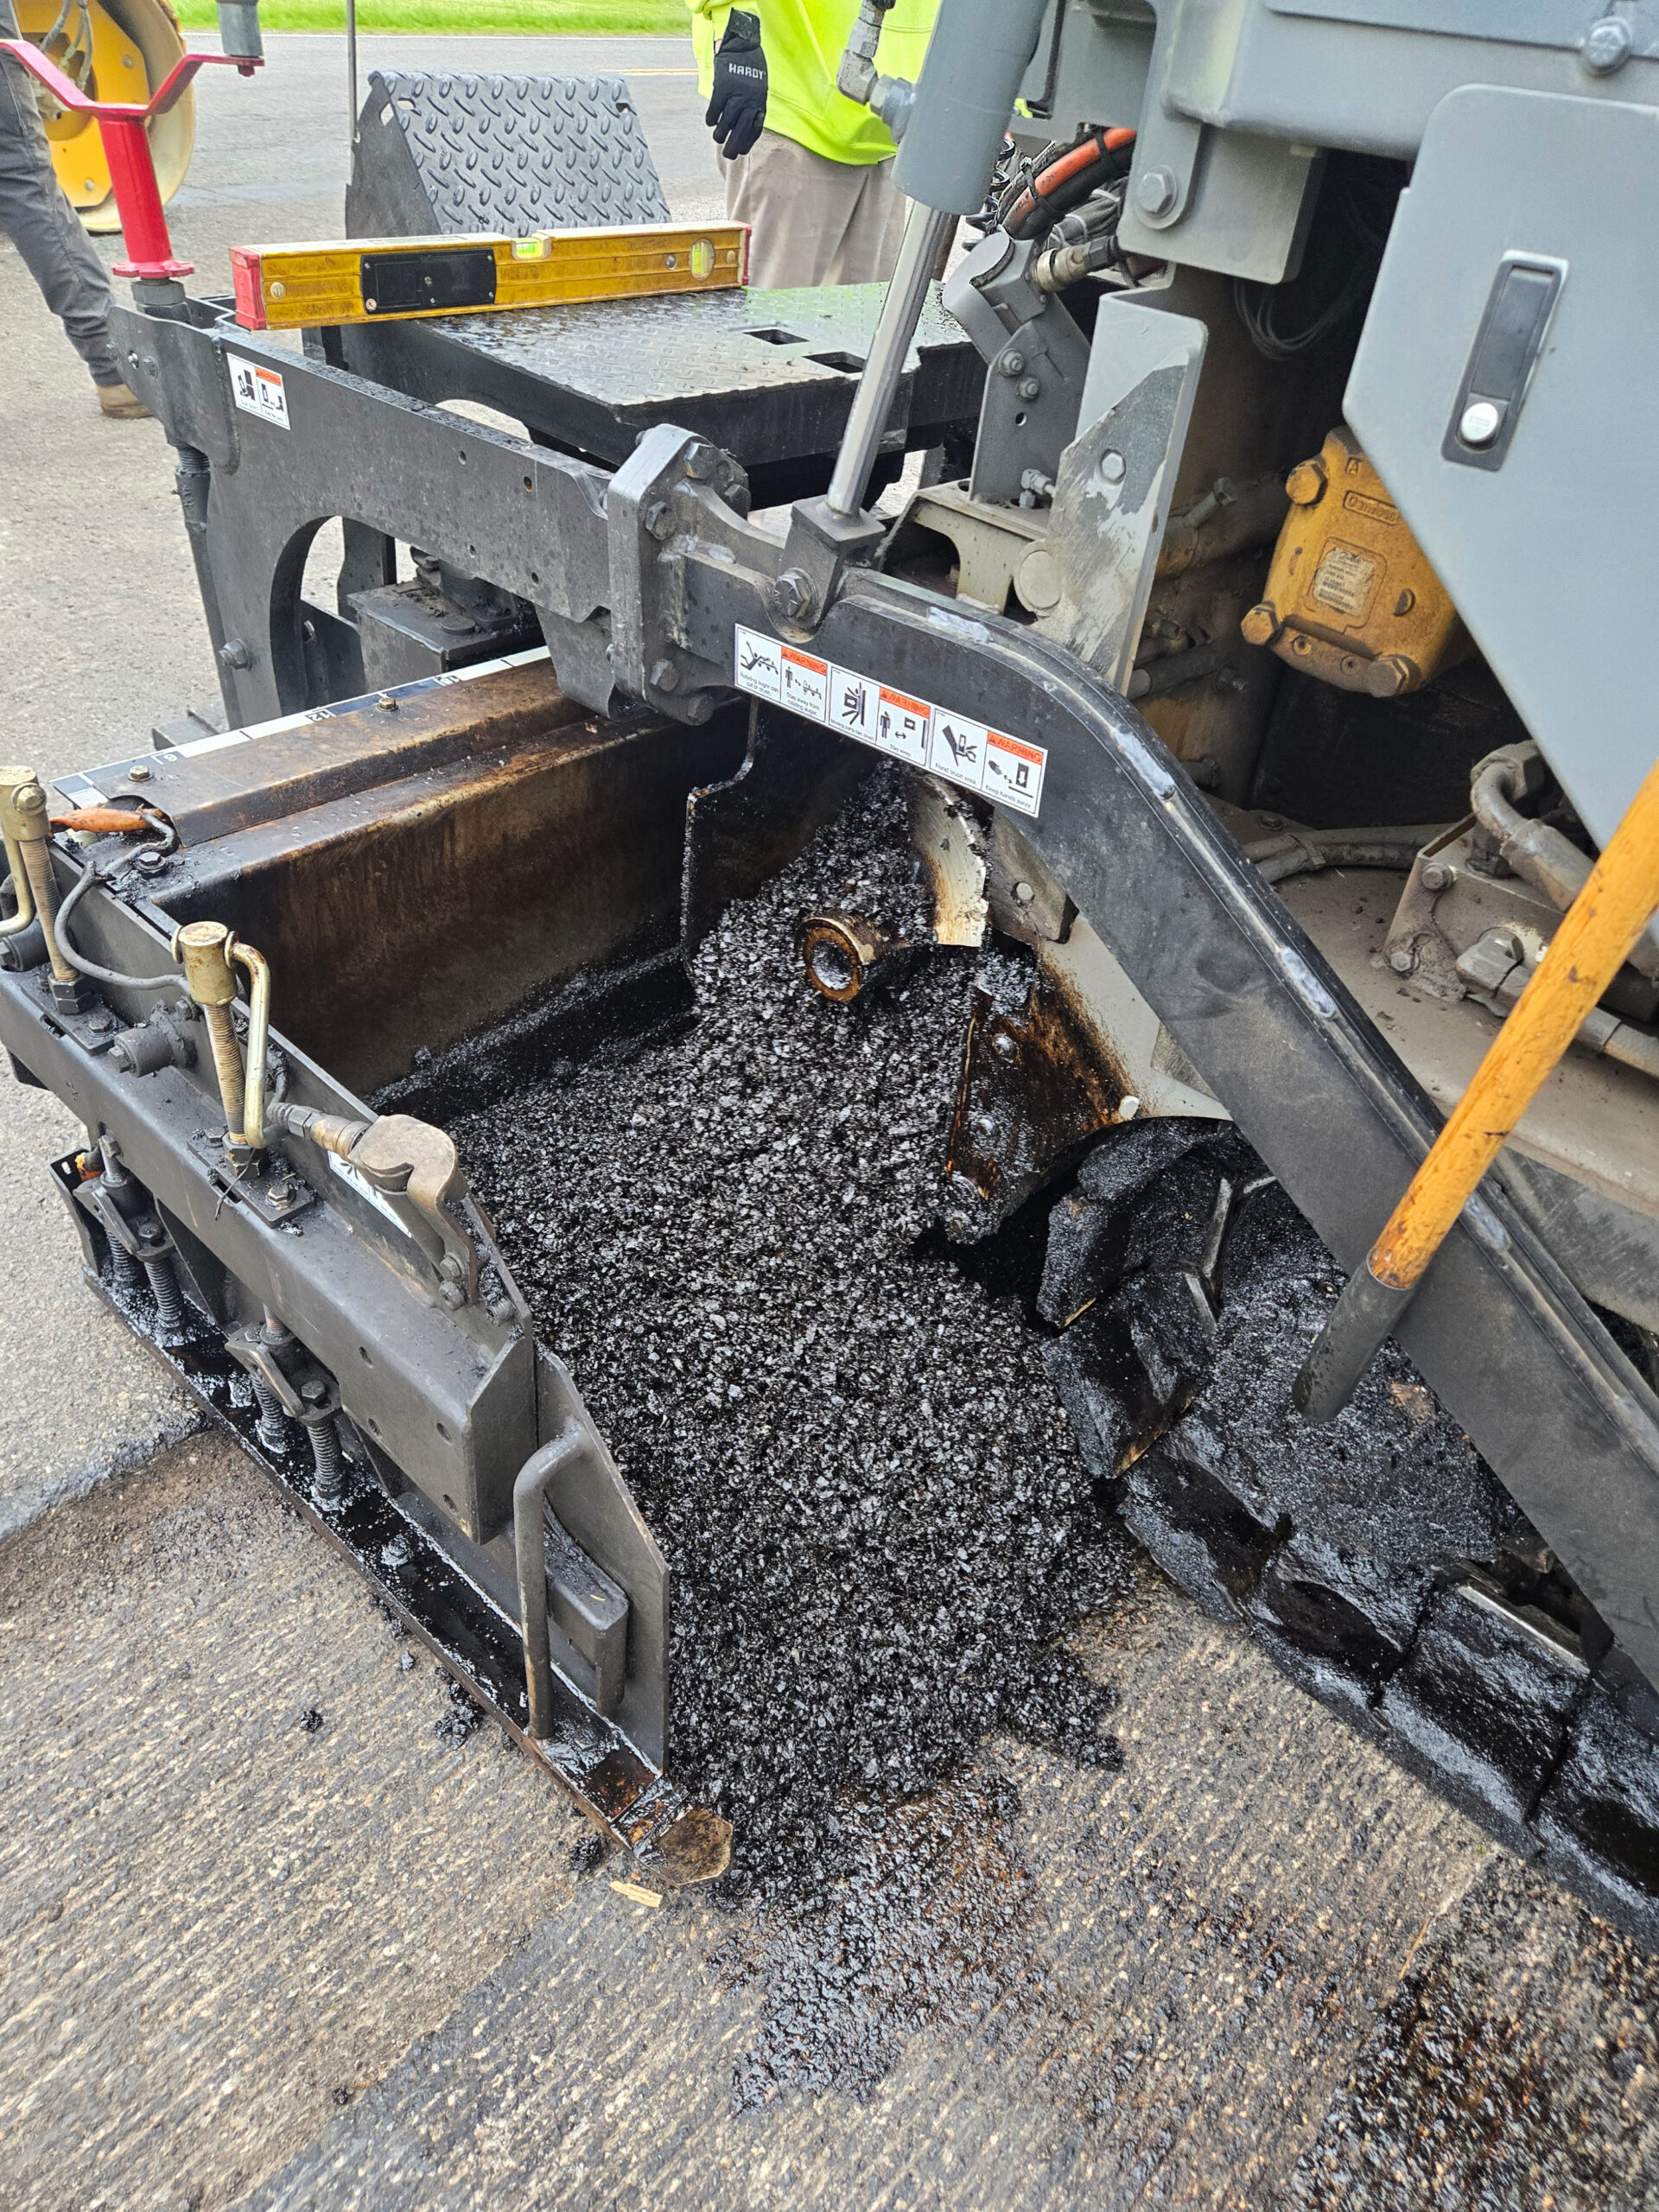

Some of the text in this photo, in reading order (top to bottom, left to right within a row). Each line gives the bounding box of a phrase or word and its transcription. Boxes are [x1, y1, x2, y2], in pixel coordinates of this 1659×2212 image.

[728, 63, 764, 79] HARDY
[790, 651, 825, 673] WARNING
[797, 697, 809, 706] away
[889, 692, 929, 715] WARNING
[998, 738, 1041, 762] WARNING
[935, 762, 949, 774] Hand
[950, 770, 963, 779] crush
[985, 785, 999, 795] Keep
[1001, 791, 1016, 802] hands
